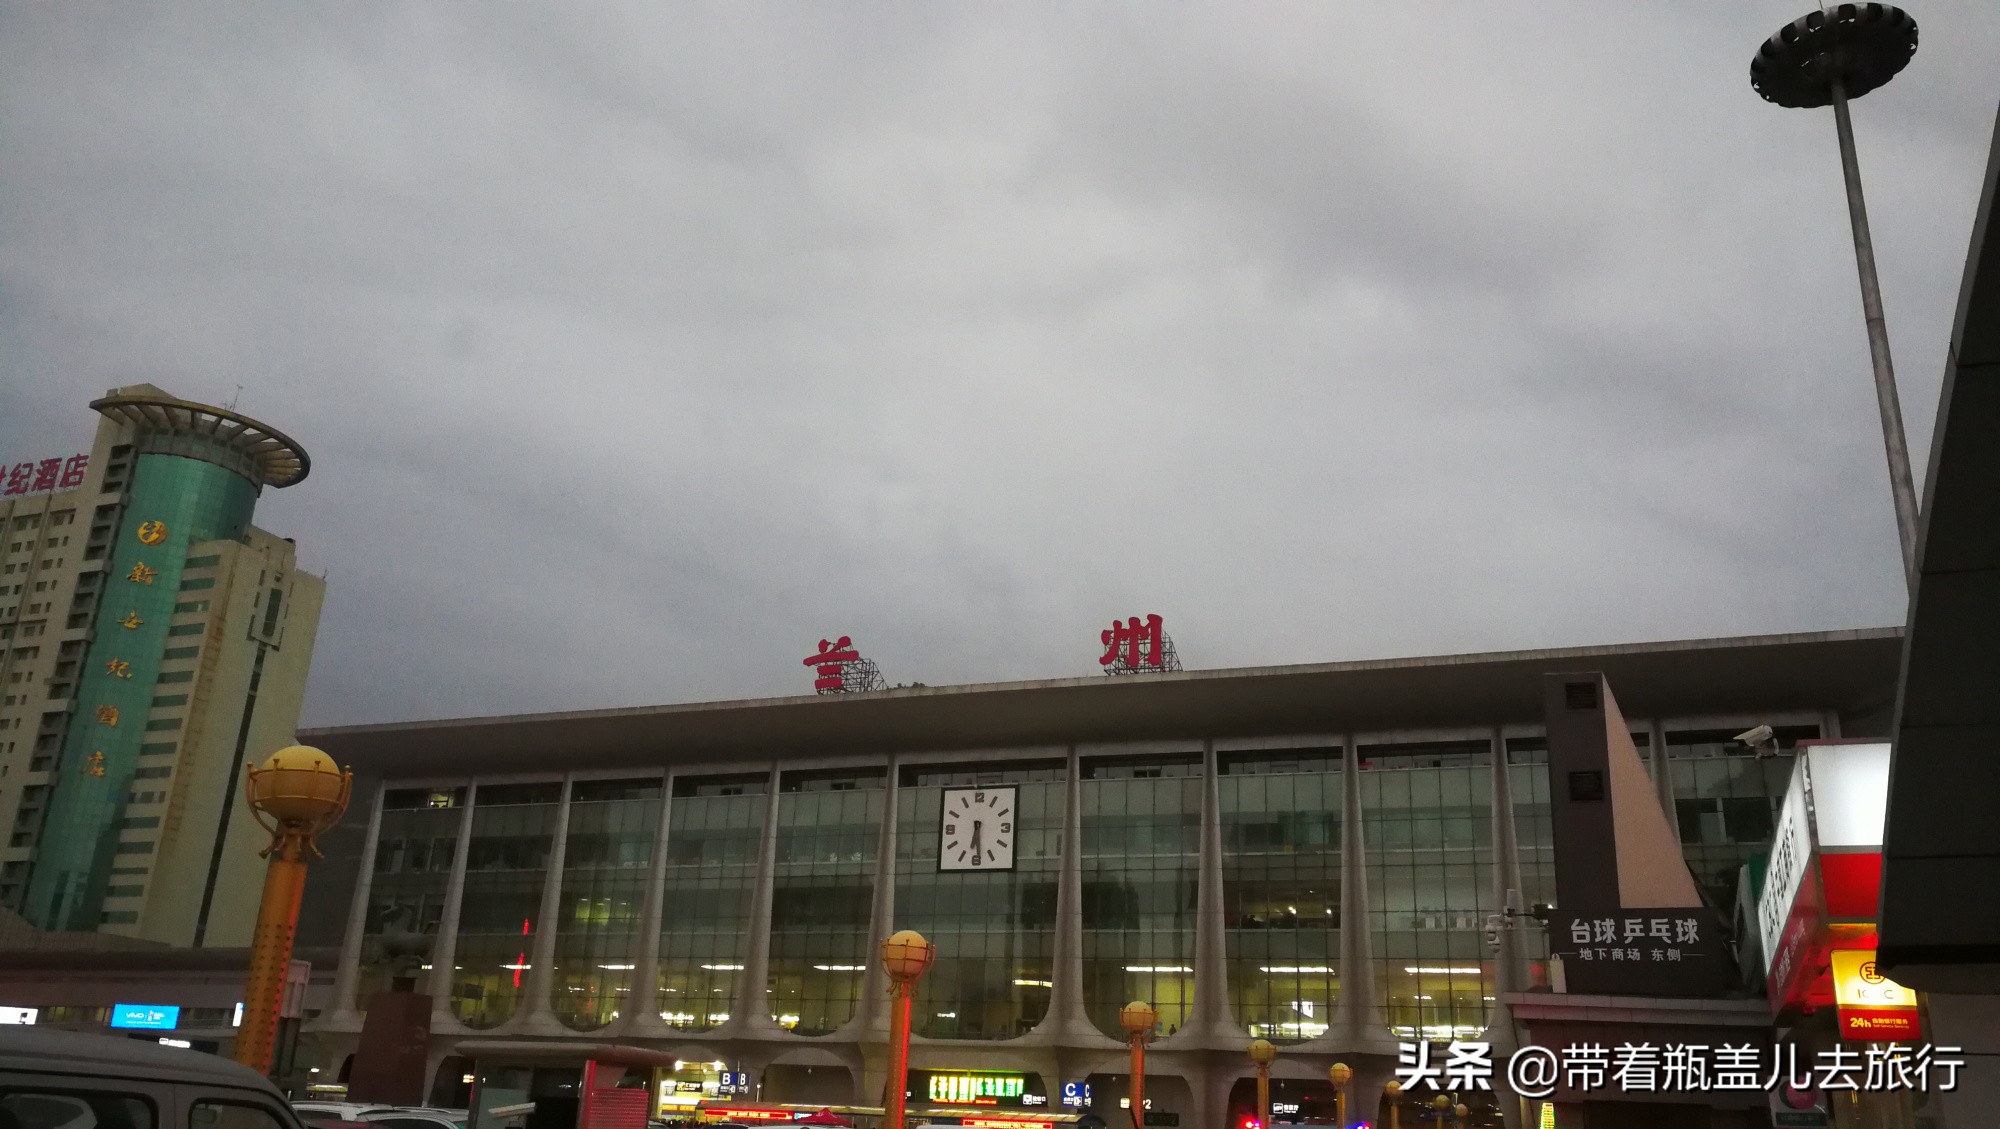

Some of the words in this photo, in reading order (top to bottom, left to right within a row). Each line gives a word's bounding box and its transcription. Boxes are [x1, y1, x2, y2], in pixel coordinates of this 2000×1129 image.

[1099, 613, 1163, 668] 州
[1000, 822, 1011, 834] 3
[1570, 918, 1700, 944] 台球乒乓球
[1579, 948, 1641, 961] 地下商场
[1650, 948, 1681, 961] 东侧
[1850, 1017, 1872, 1028] 24h
[722, 1072, 732, 1085] B
[740, 1073, 746, 1085] B
[1065, 1083, 1077, 1097] C
[1084, 1084, 1090, 1098] C
